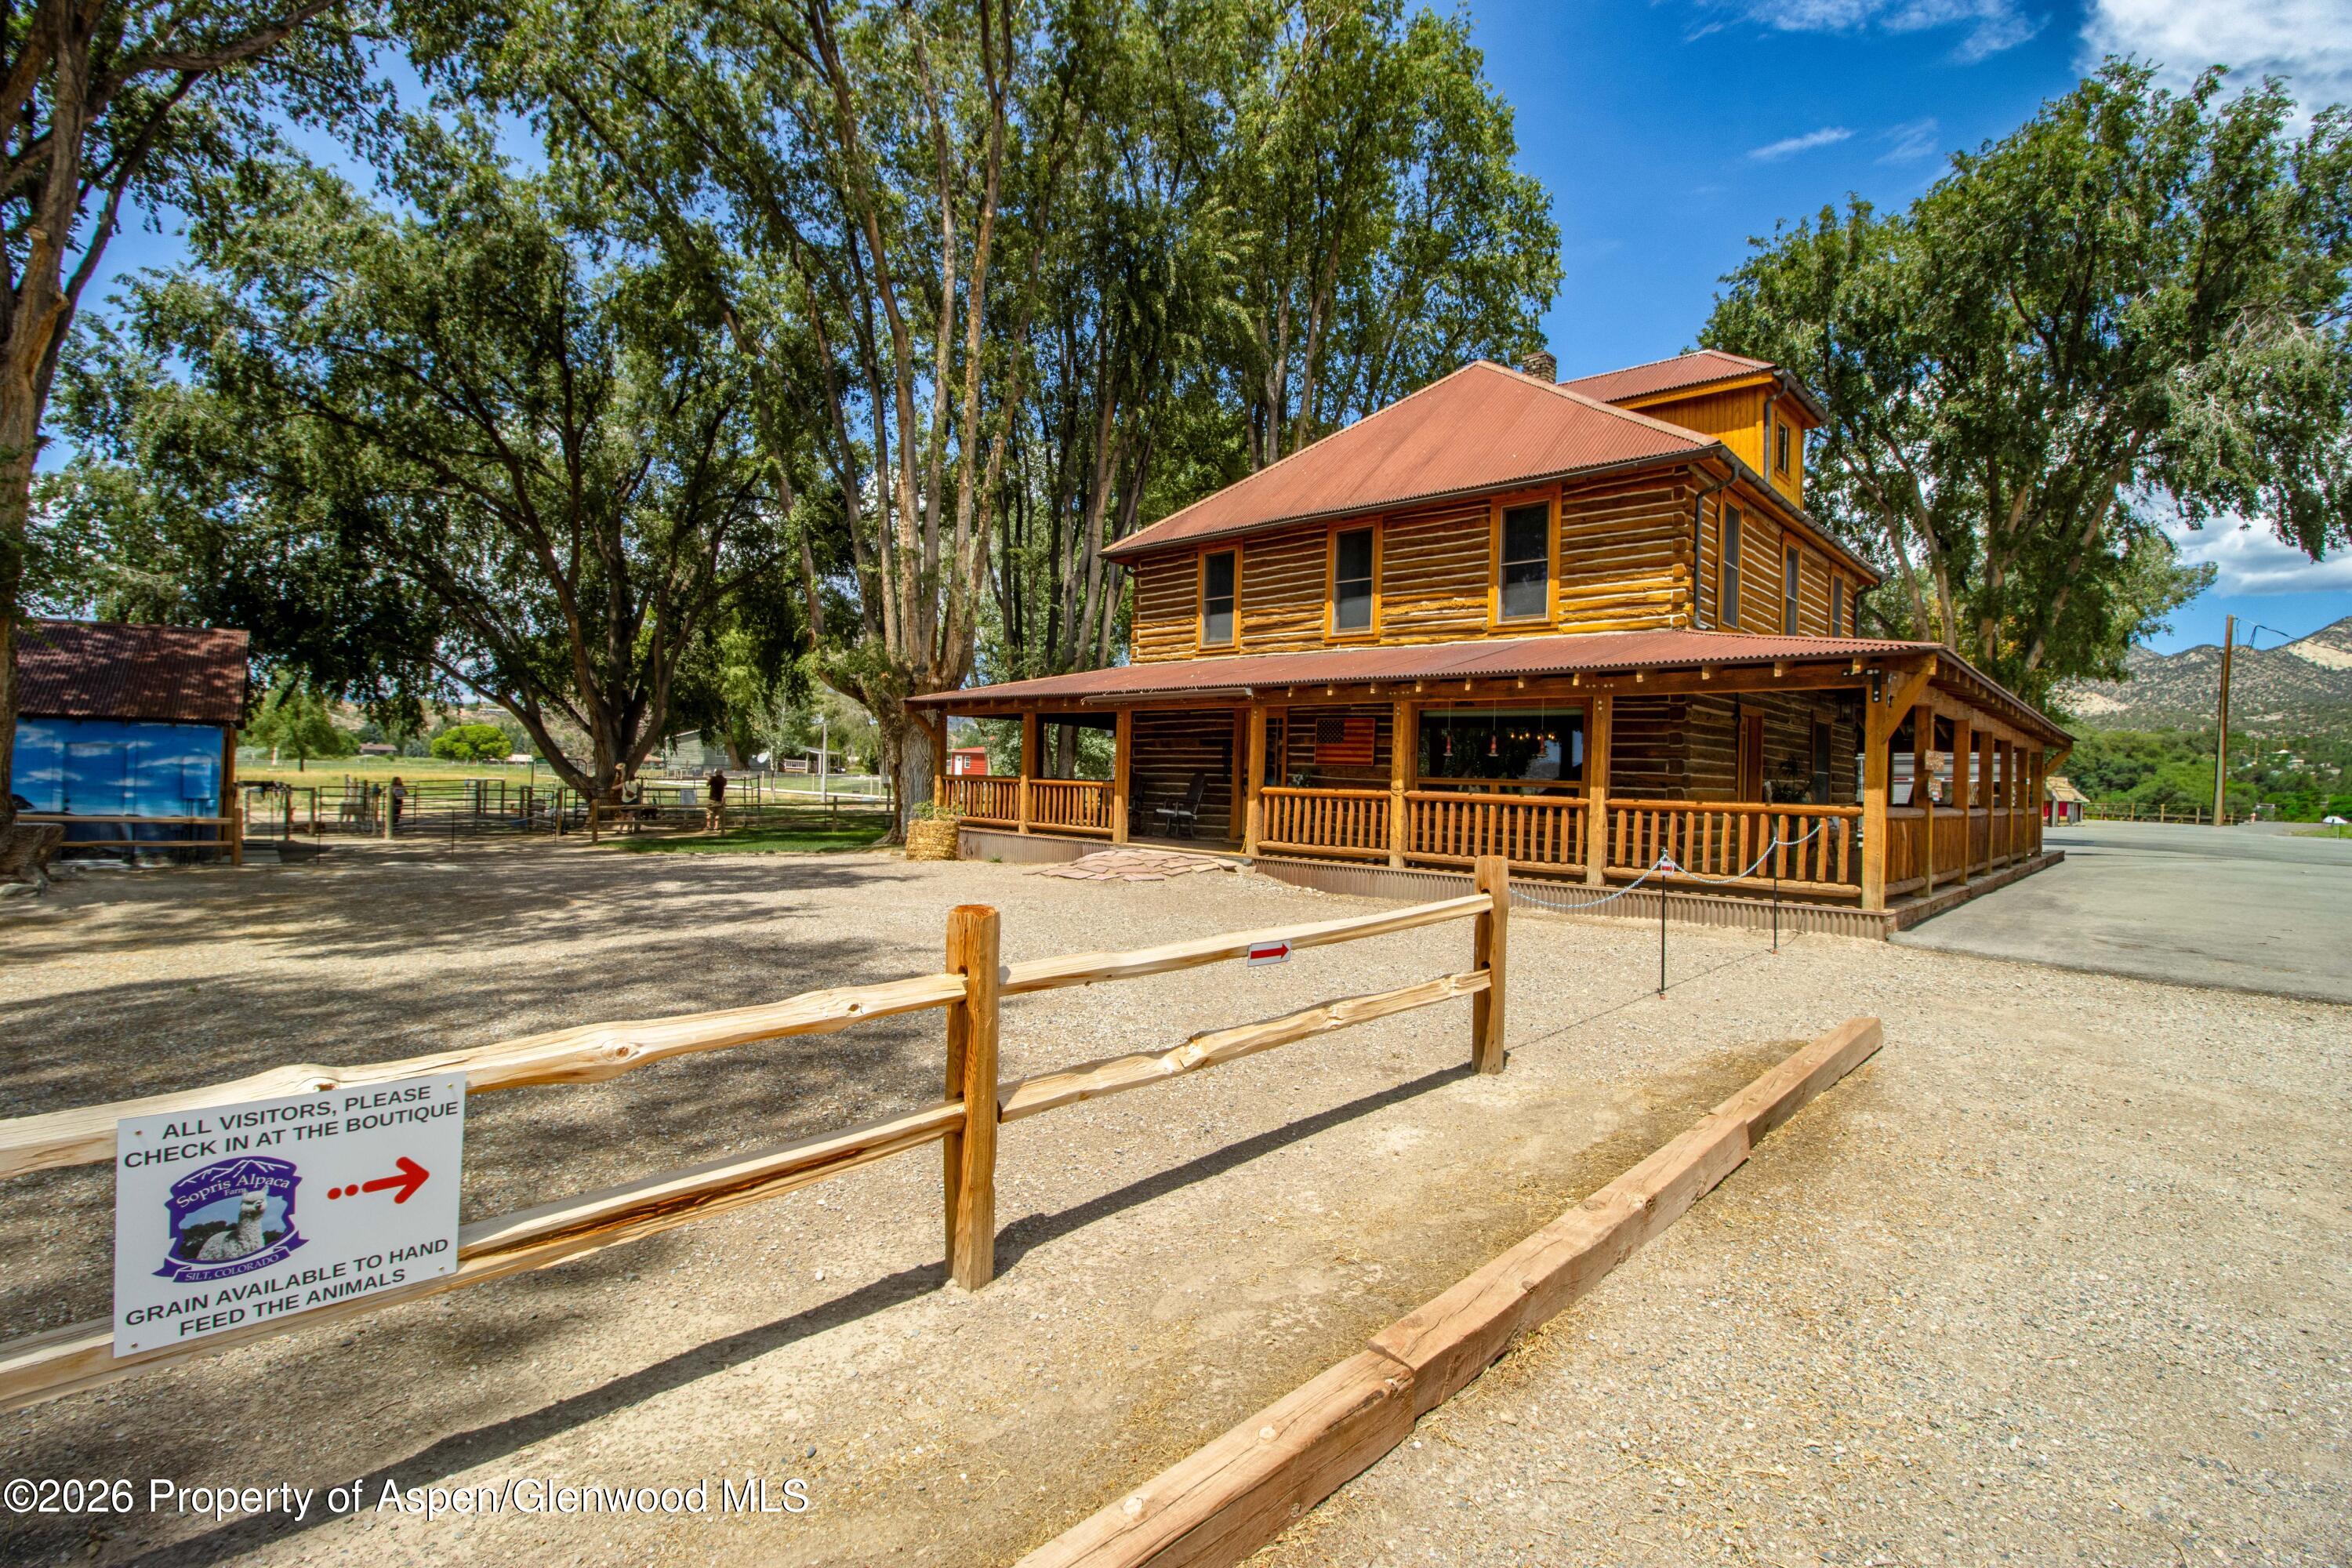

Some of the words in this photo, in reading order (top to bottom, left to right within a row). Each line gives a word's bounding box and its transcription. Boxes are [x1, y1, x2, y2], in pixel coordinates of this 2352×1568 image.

[124, 1140, 216, 1168] CHECK
[225, 1134, 249, 1152] IN
[256, 1129, 287, 1148] AT
[292, 1120, 339, 1142] THE
[346, 1101, 459, 1133] BOUTIQUE
[162, 1120, 212, 1140] ALL
[219, 1101, 337, 1131] VISITORS,
[346, 1085, 431, 1112] PLEASE
[176, 1180, 231, 1208] Sopris
[235, 1173, 290, 1189] Alpaca
[125, 1294, 209, 1326] GRAIN
[215, 1262, 347, 1306] AVAILABLE
[353, 1254, 383, 1273] TO
[389, 1239, 448, 1265] HAND
[214, 1254, 279, 1278] COLORADO
[180, 1308, 245, 1337] FEED
[252, 1294, 299, 1317] THE
[306, 1269, 406, 1305] ANIMALS
